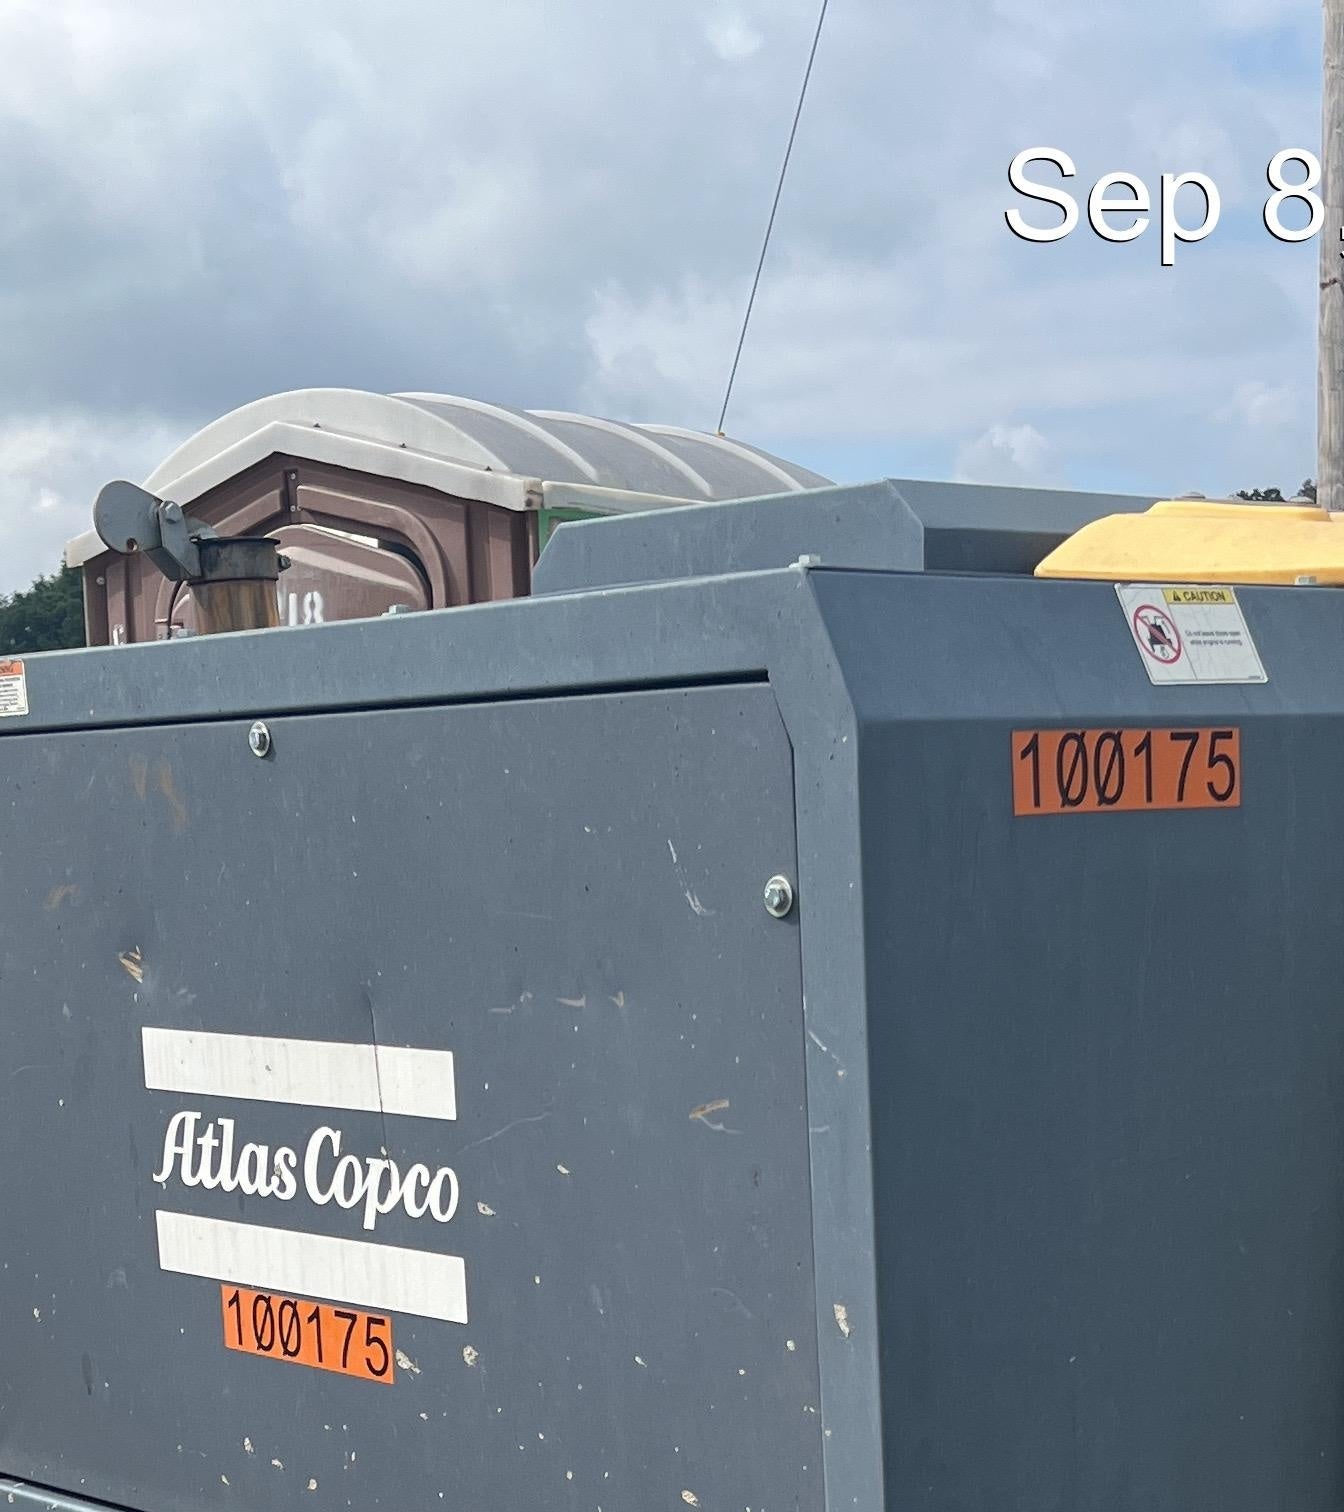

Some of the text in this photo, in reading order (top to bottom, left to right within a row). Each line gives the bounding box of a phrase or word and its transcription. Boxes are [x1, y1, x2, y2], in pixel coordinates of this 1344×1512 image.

[1182, 590, 1226, 602] CAUTION
[1019, 730, 1236, 809] 100175
[152, 1110, 459, 1231] Atlas Copco
[227, 1289, 390, 1377] 100175
